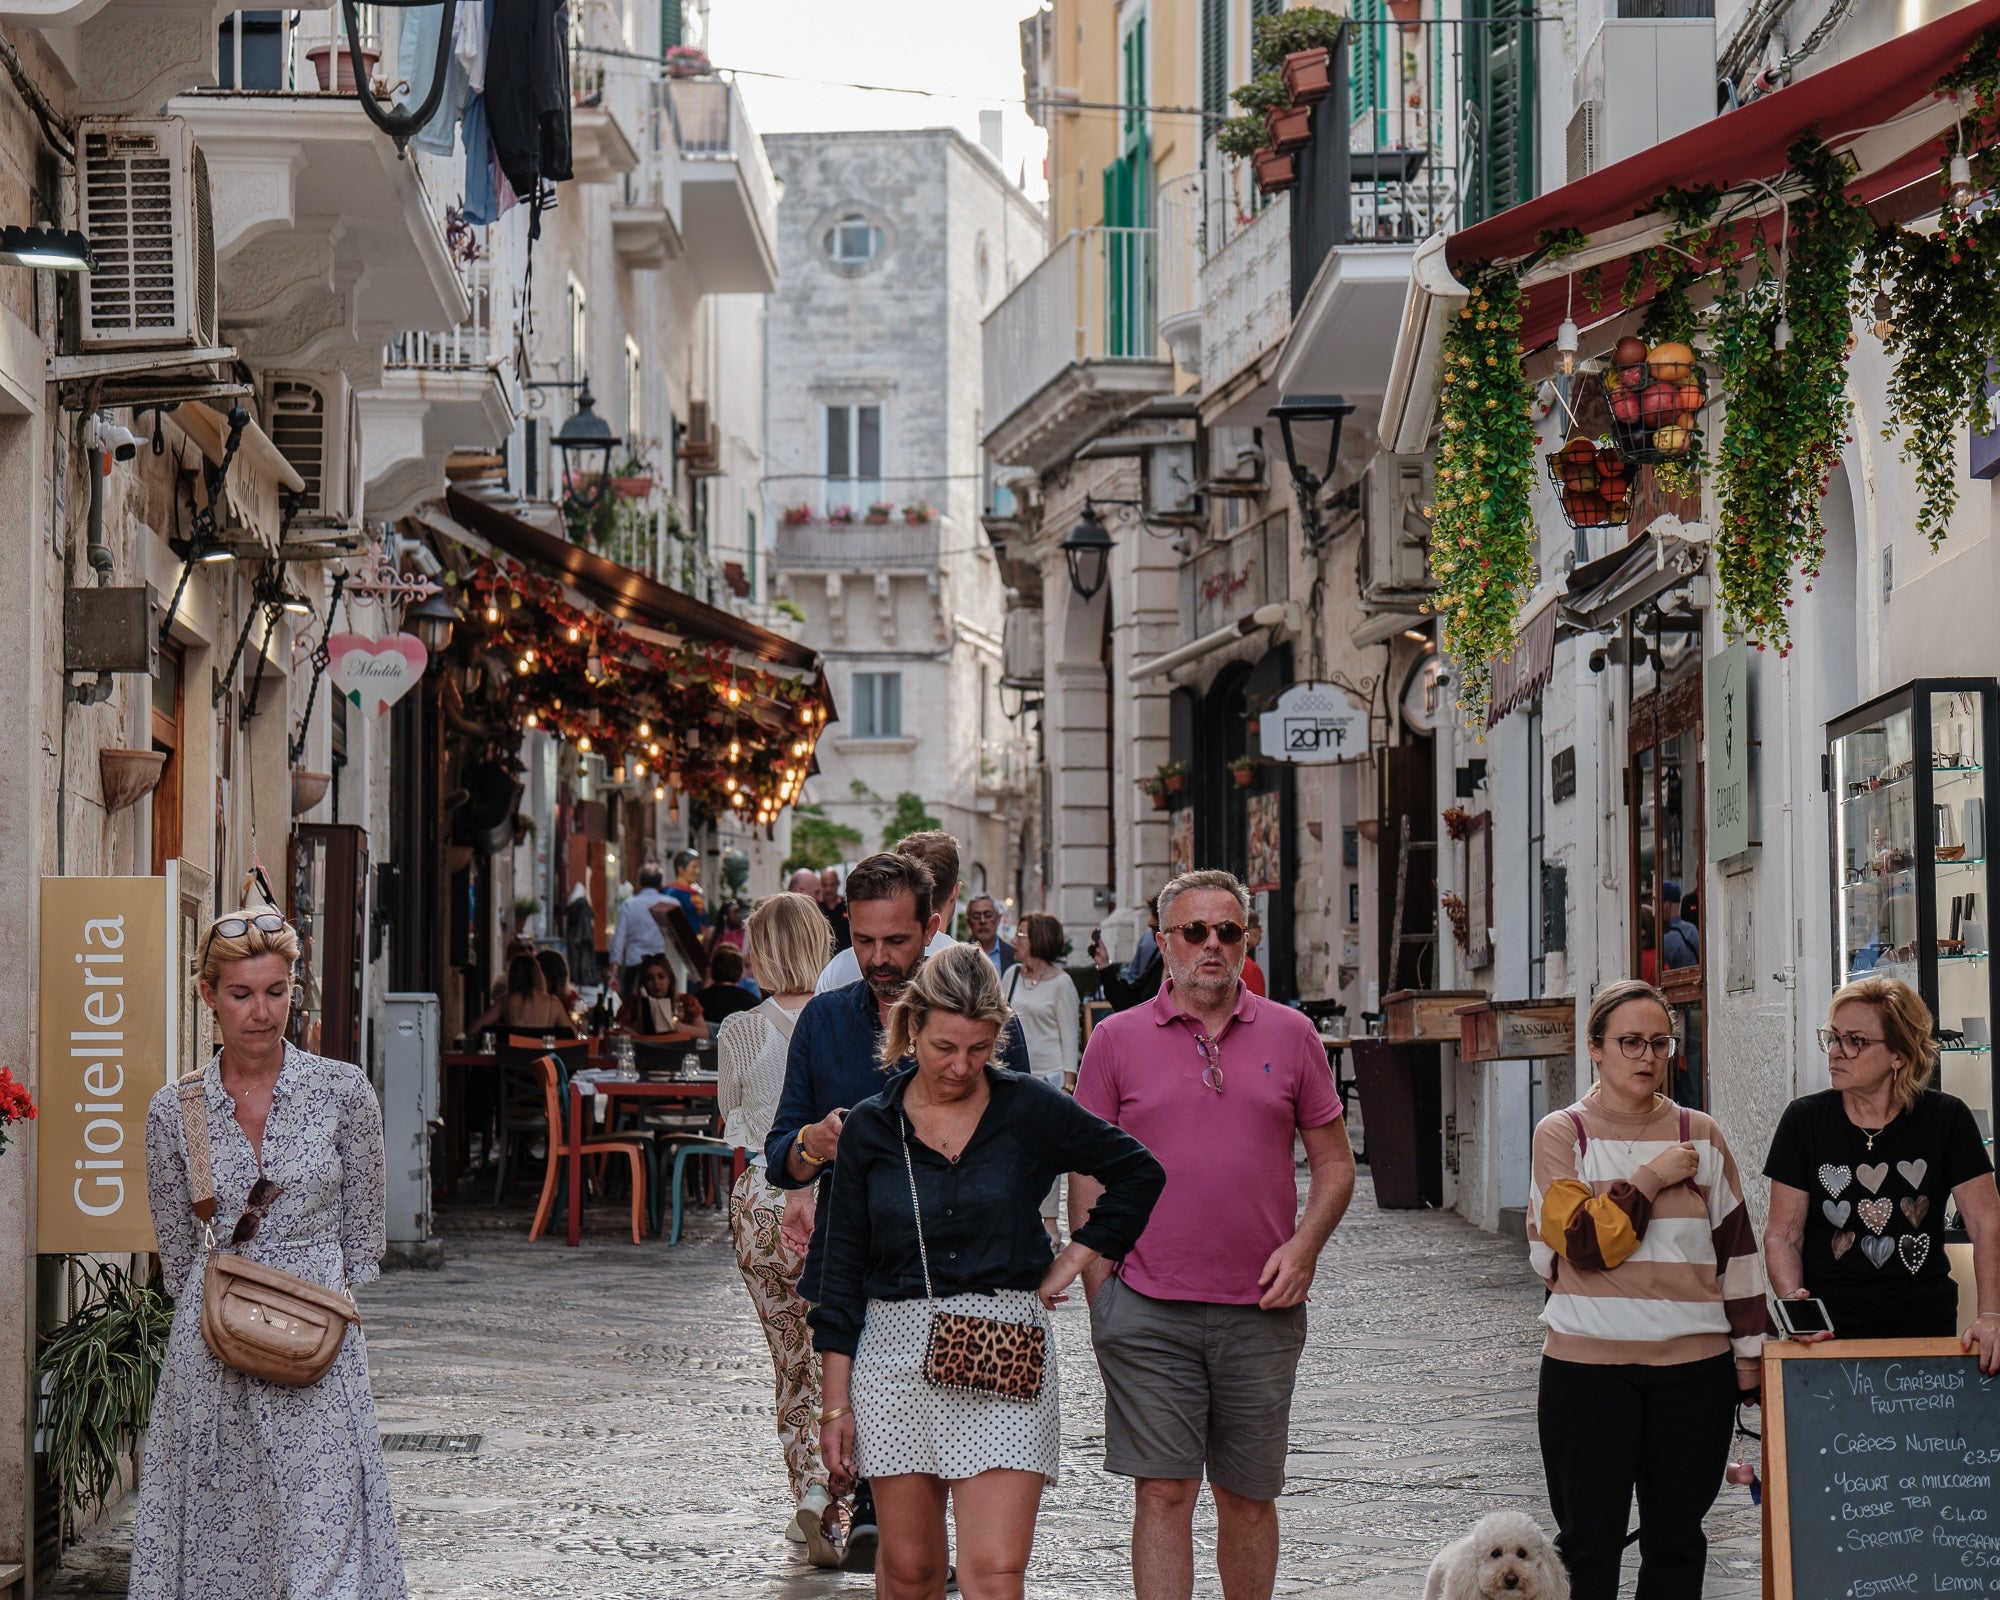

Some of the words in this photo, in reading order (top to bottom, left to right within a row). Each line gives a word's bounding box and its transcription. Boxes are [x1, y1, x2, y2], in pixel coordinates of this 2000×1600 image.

[1511, 1022, 1569, 1036] SASSICAIA
[70, 914, 125, 1217] Gioielleria
[1962, 1449, 2000, 1465] €3,5
[1940, 1505, 1988, 1522] €4,00
